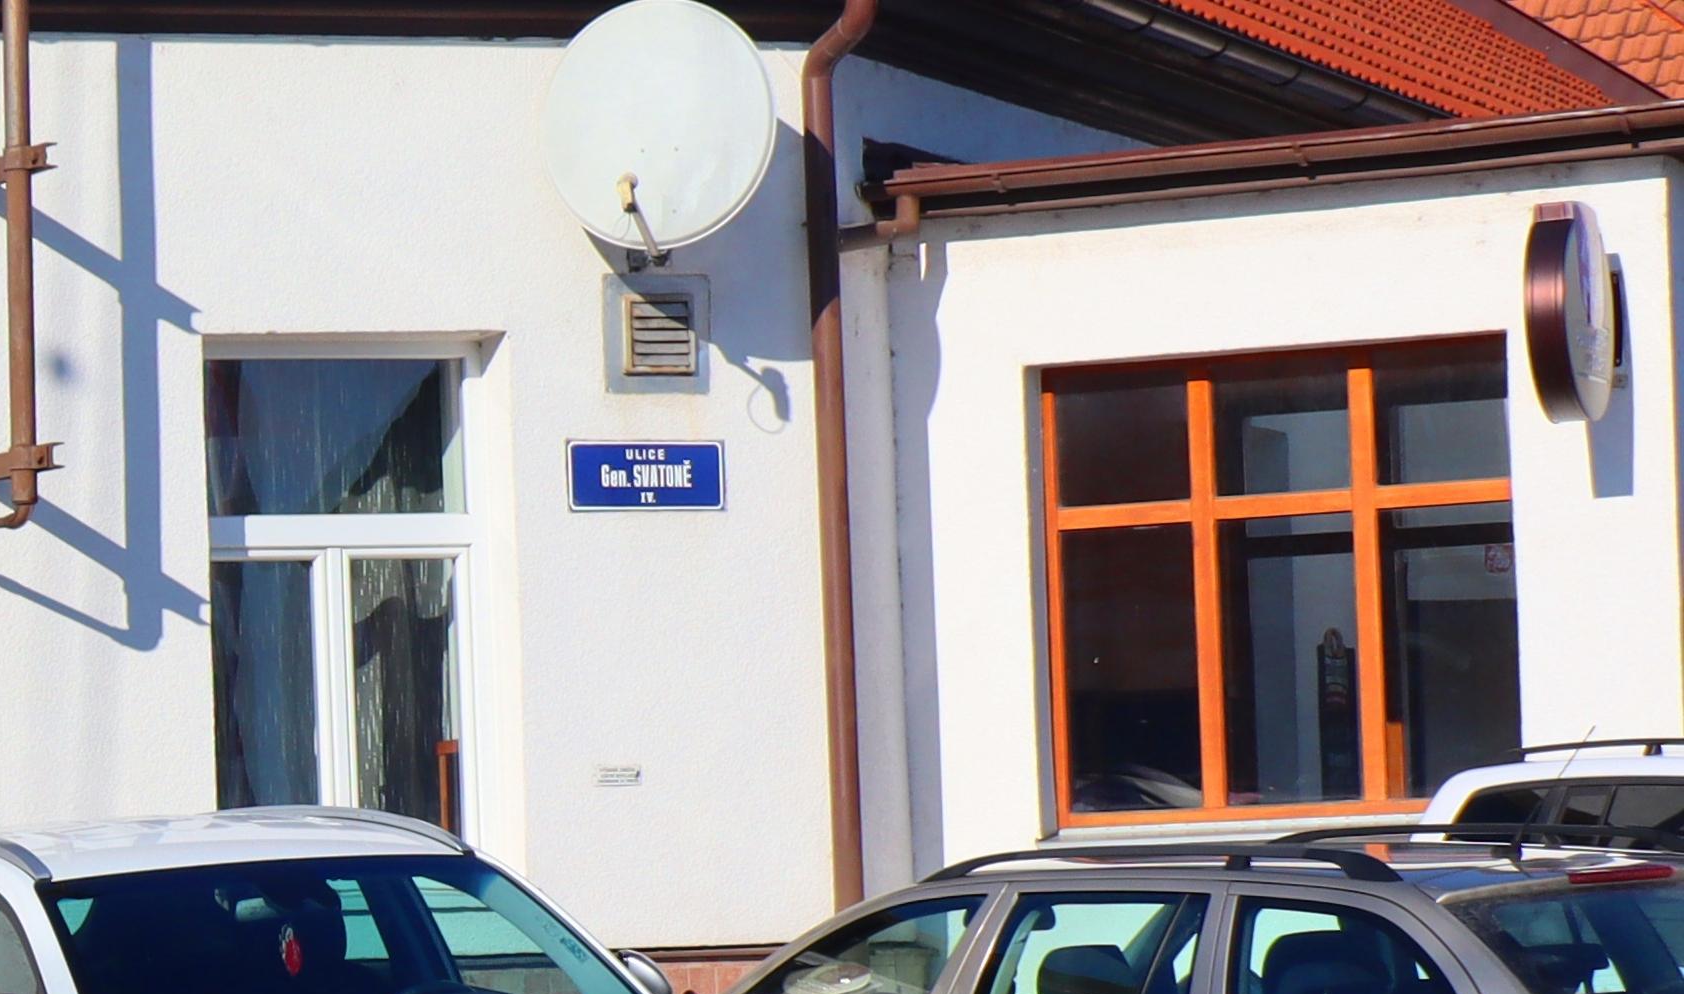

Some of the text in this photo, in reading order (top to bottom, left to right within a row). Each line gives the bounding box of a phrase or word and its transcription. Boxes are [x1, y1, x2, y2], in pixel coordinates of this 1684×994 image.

[625, 448, 666, 461] ULICE
[600, 459, 693, 488] Gen. SVATONĚ
